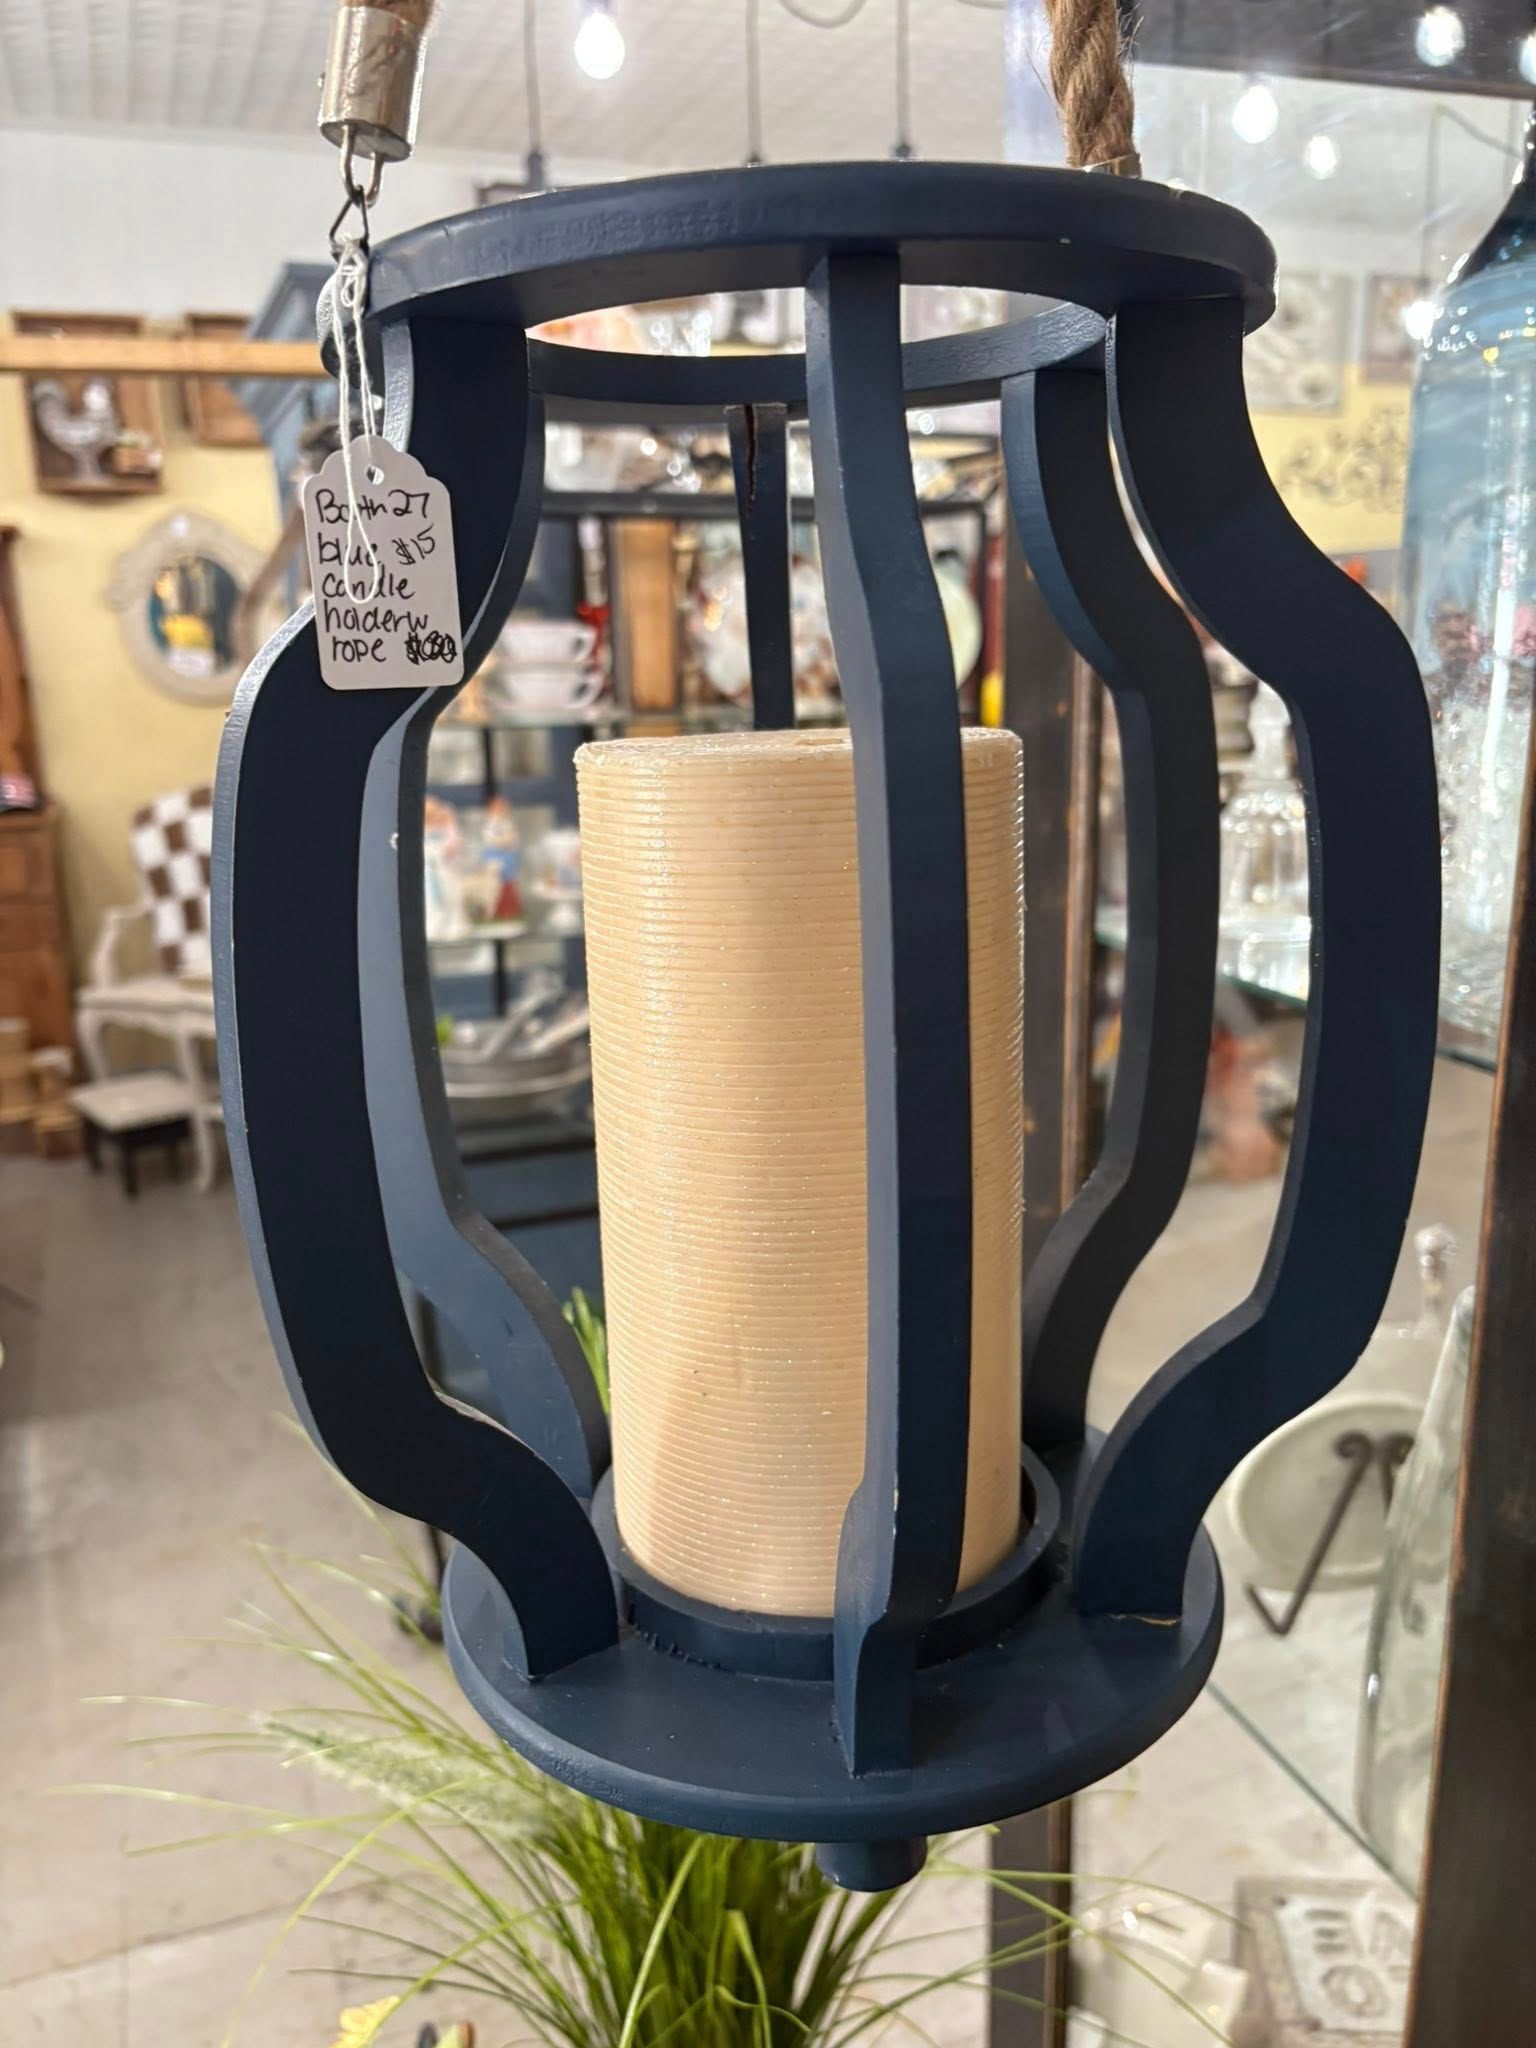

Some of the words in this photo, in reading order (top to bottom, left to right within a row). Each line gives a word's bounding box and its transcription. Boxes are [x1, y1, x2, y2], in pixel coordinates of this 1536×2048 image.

[387, 488, 430, 519] 27
[317, 531, 382, 567] blue
[391, 523, 436, 566] $15
[322, 564, 416, 600] candle
[332, 635, 387, 663] rope
